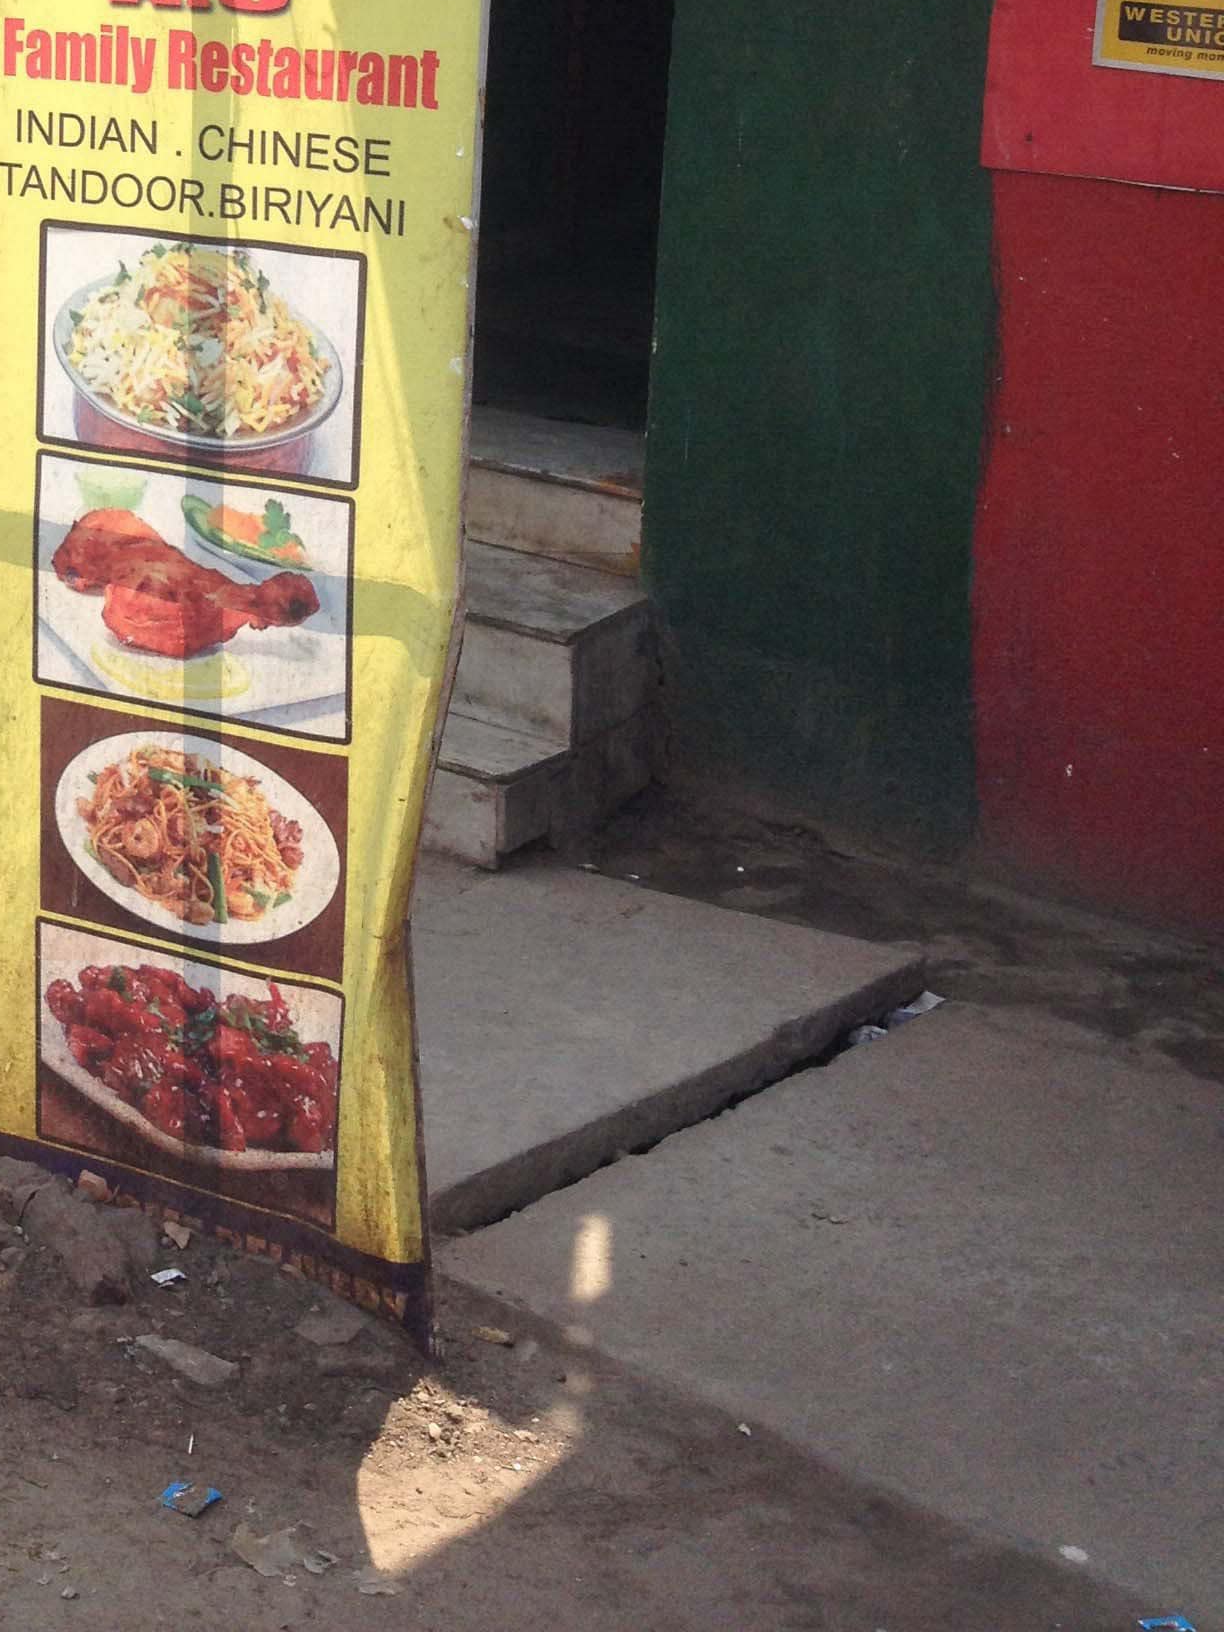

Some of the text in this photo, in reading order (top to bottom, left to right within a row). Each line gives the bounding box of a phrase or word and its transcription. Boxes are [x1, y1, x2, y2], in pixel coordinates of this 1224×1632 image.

[3, 17, 441, 110] Family Restaurant
[1146, 47, 1193, 61] moving
[15, 108, 159, 156] INDIAN
[198, 123, 392, 177] CHINESE
